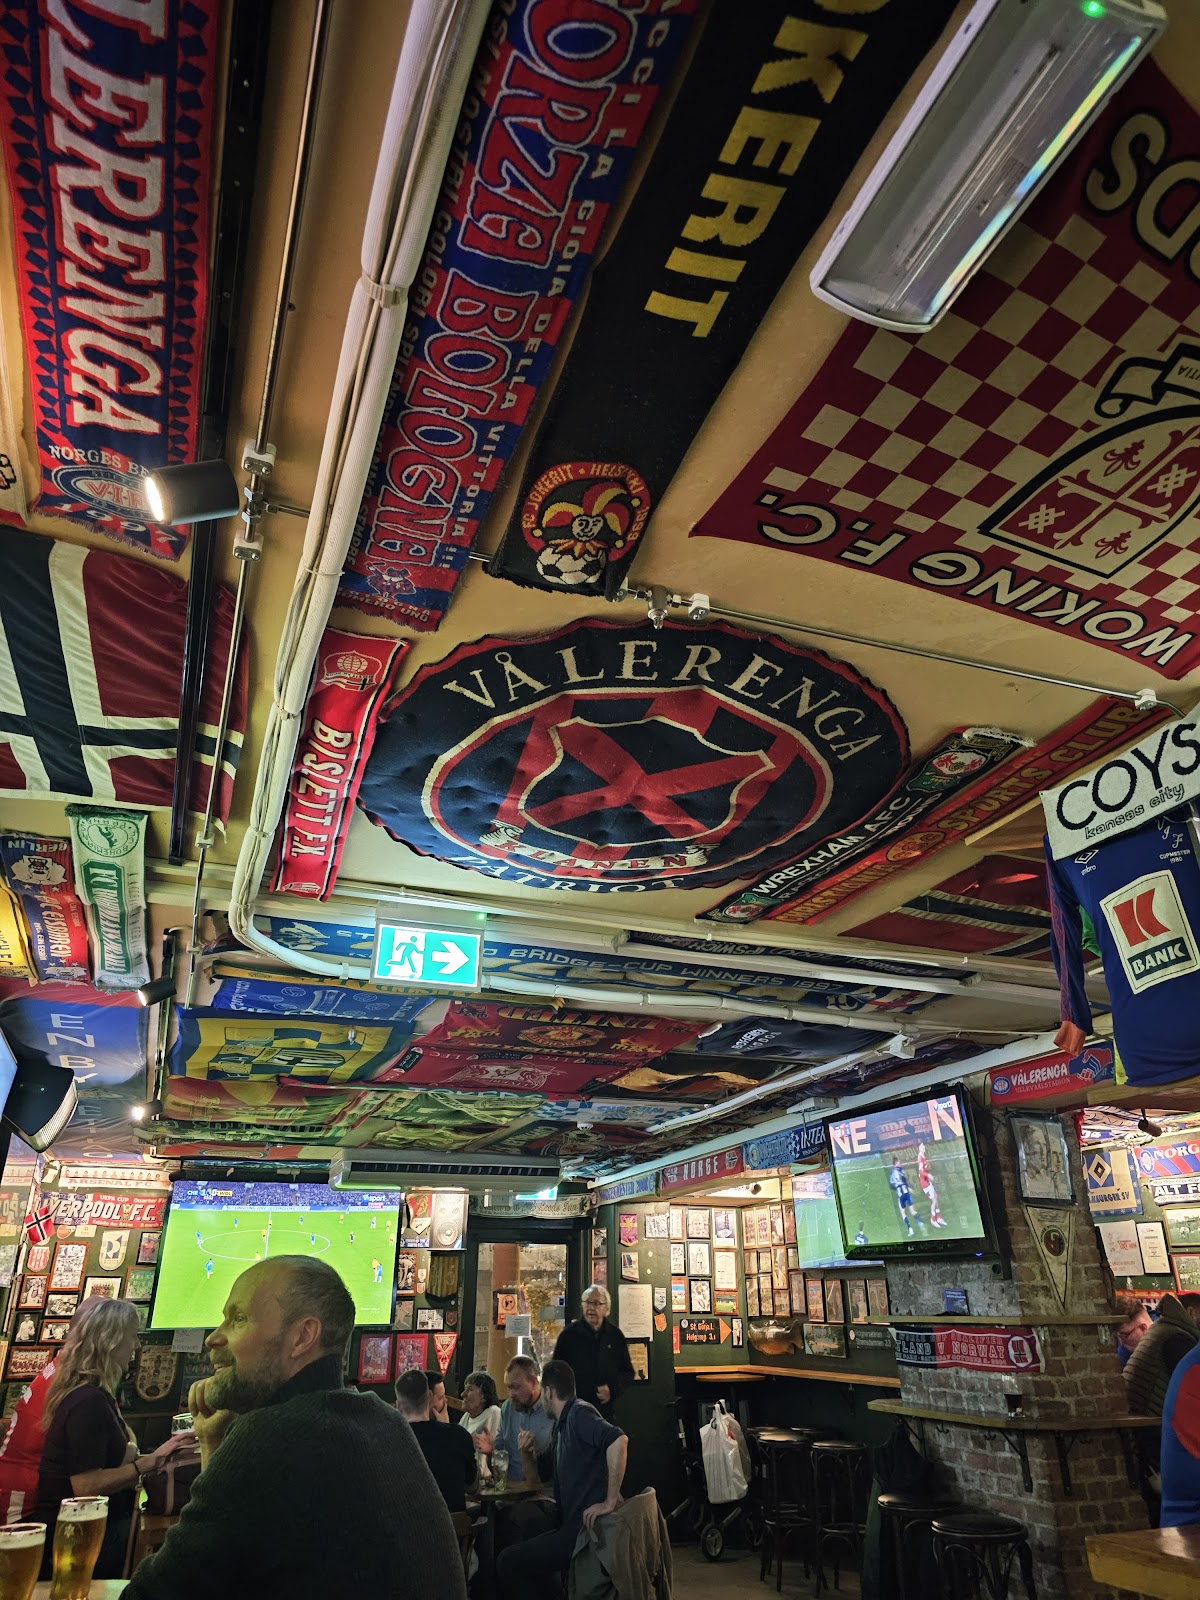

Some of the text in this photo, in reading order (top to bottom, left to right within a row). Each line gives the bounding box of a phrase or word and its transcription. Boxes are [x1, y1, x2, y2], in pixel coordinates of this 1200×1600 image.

[1084, 112, 1200, 283] DS
[549, 198, 595, 299] GIOIA
[366, 0, 645, 567] ORZA BOLOGNA
[500, 312, 552, 412] DELLA
[49, 444, 122, 469] NORGES
[449, 424, 508, 538] VITTORIA
[529, 463, 575, 511] JOKERIT
[755, 490, 1193, 667] WOKING F.C.
[442, 640, 882, 760] VÅLERENGA
[294, 718, 354, 826] BISLETT
[936, 766, 1053, 832] SPORTS
[1048, 705, 1150, 763] CLUB
[1055, 722, 1200, 831] COYS
[1084, 783, 1186, 840] kansas city
[7, 839, 68, 853] BERLIN
[501, 840, 690, 871] KLANEN
[752, 796, 912, 894] WREXHAM AFC
[508, 947, 674, 974] BRIDGE-CUP
[680, 966, 786, 988] WINNERS
[792, 977, 844, 992] 1997
[1130, 942, 1187, 976] BANK
[1010, 1062, 1069, 1087] VÅLERENGA
[683, 1156, 719, 1181] NORGE
[1154, 1184, 1181, 1198] ALT
[130, 1203, 157, 1222] F.C.
[951, 1342, 1006, 1358] NORWAY
